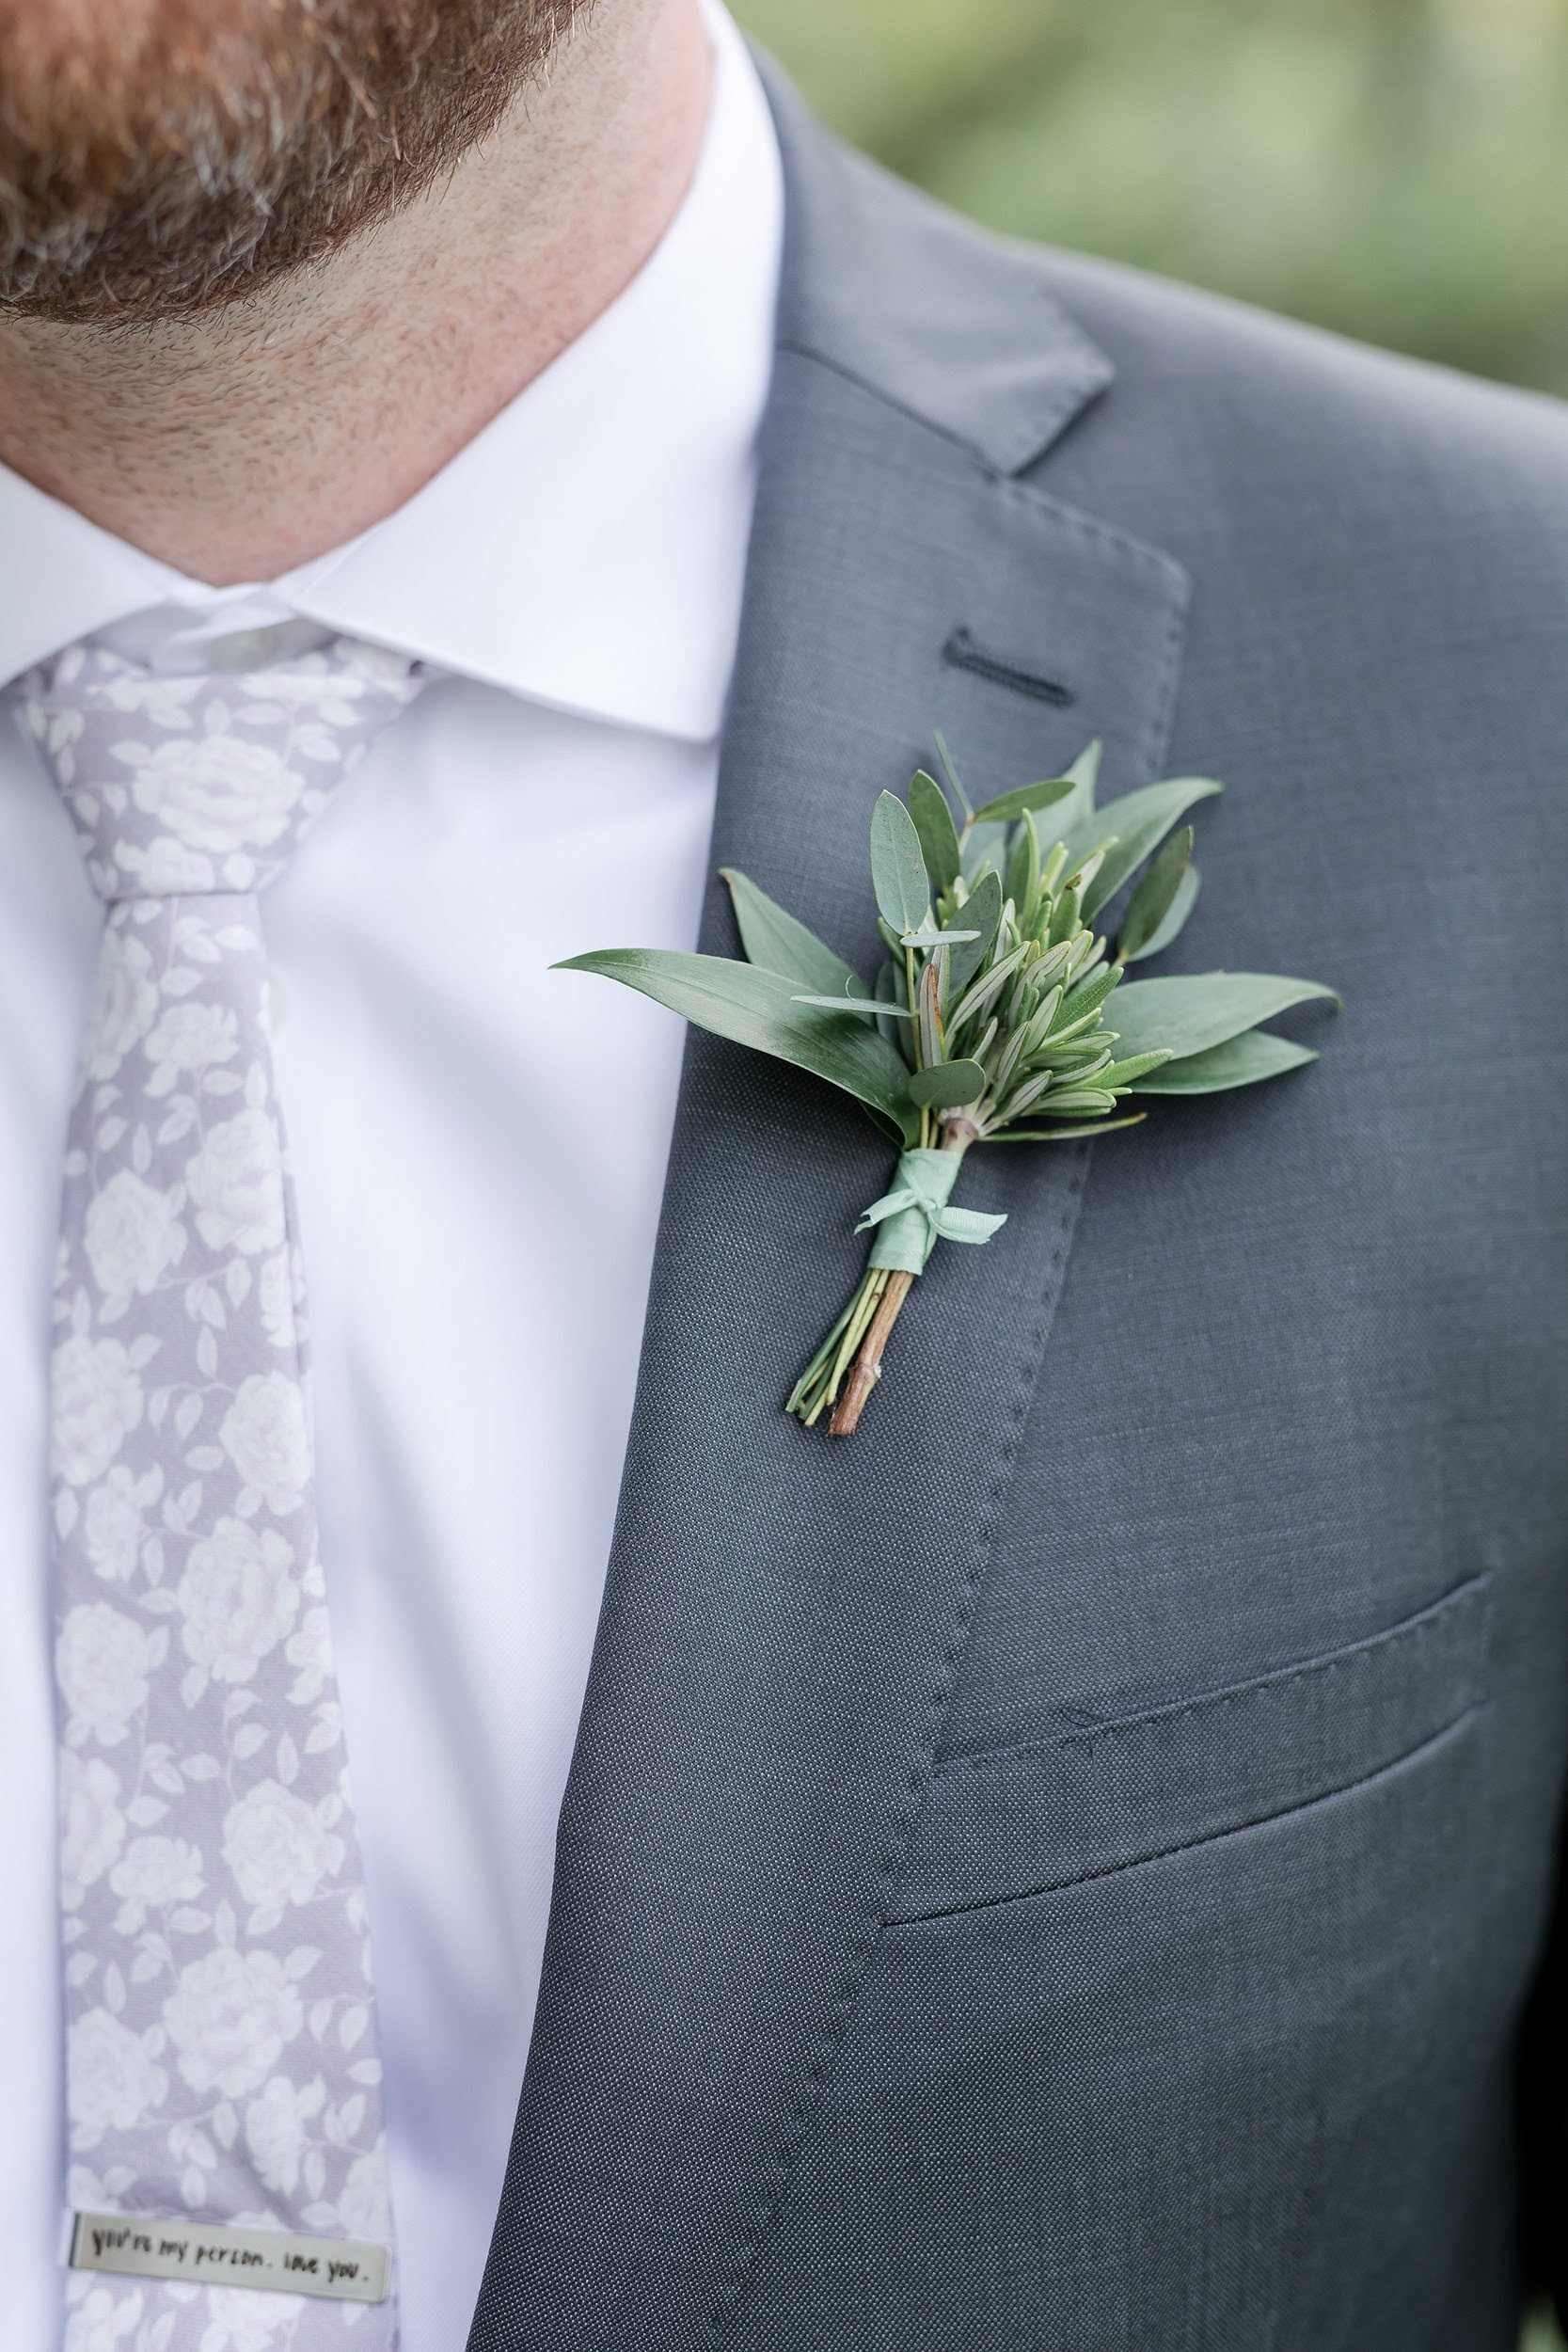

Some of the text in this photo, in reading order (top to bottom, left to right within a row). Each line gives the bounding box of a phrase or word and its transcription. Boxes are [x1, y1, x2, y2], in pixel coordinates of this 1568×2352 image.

[92, 2227, 151, 2256] you're
[159, 2238, 188, 2263] my
[196, 2245, 273, 2268] person.
